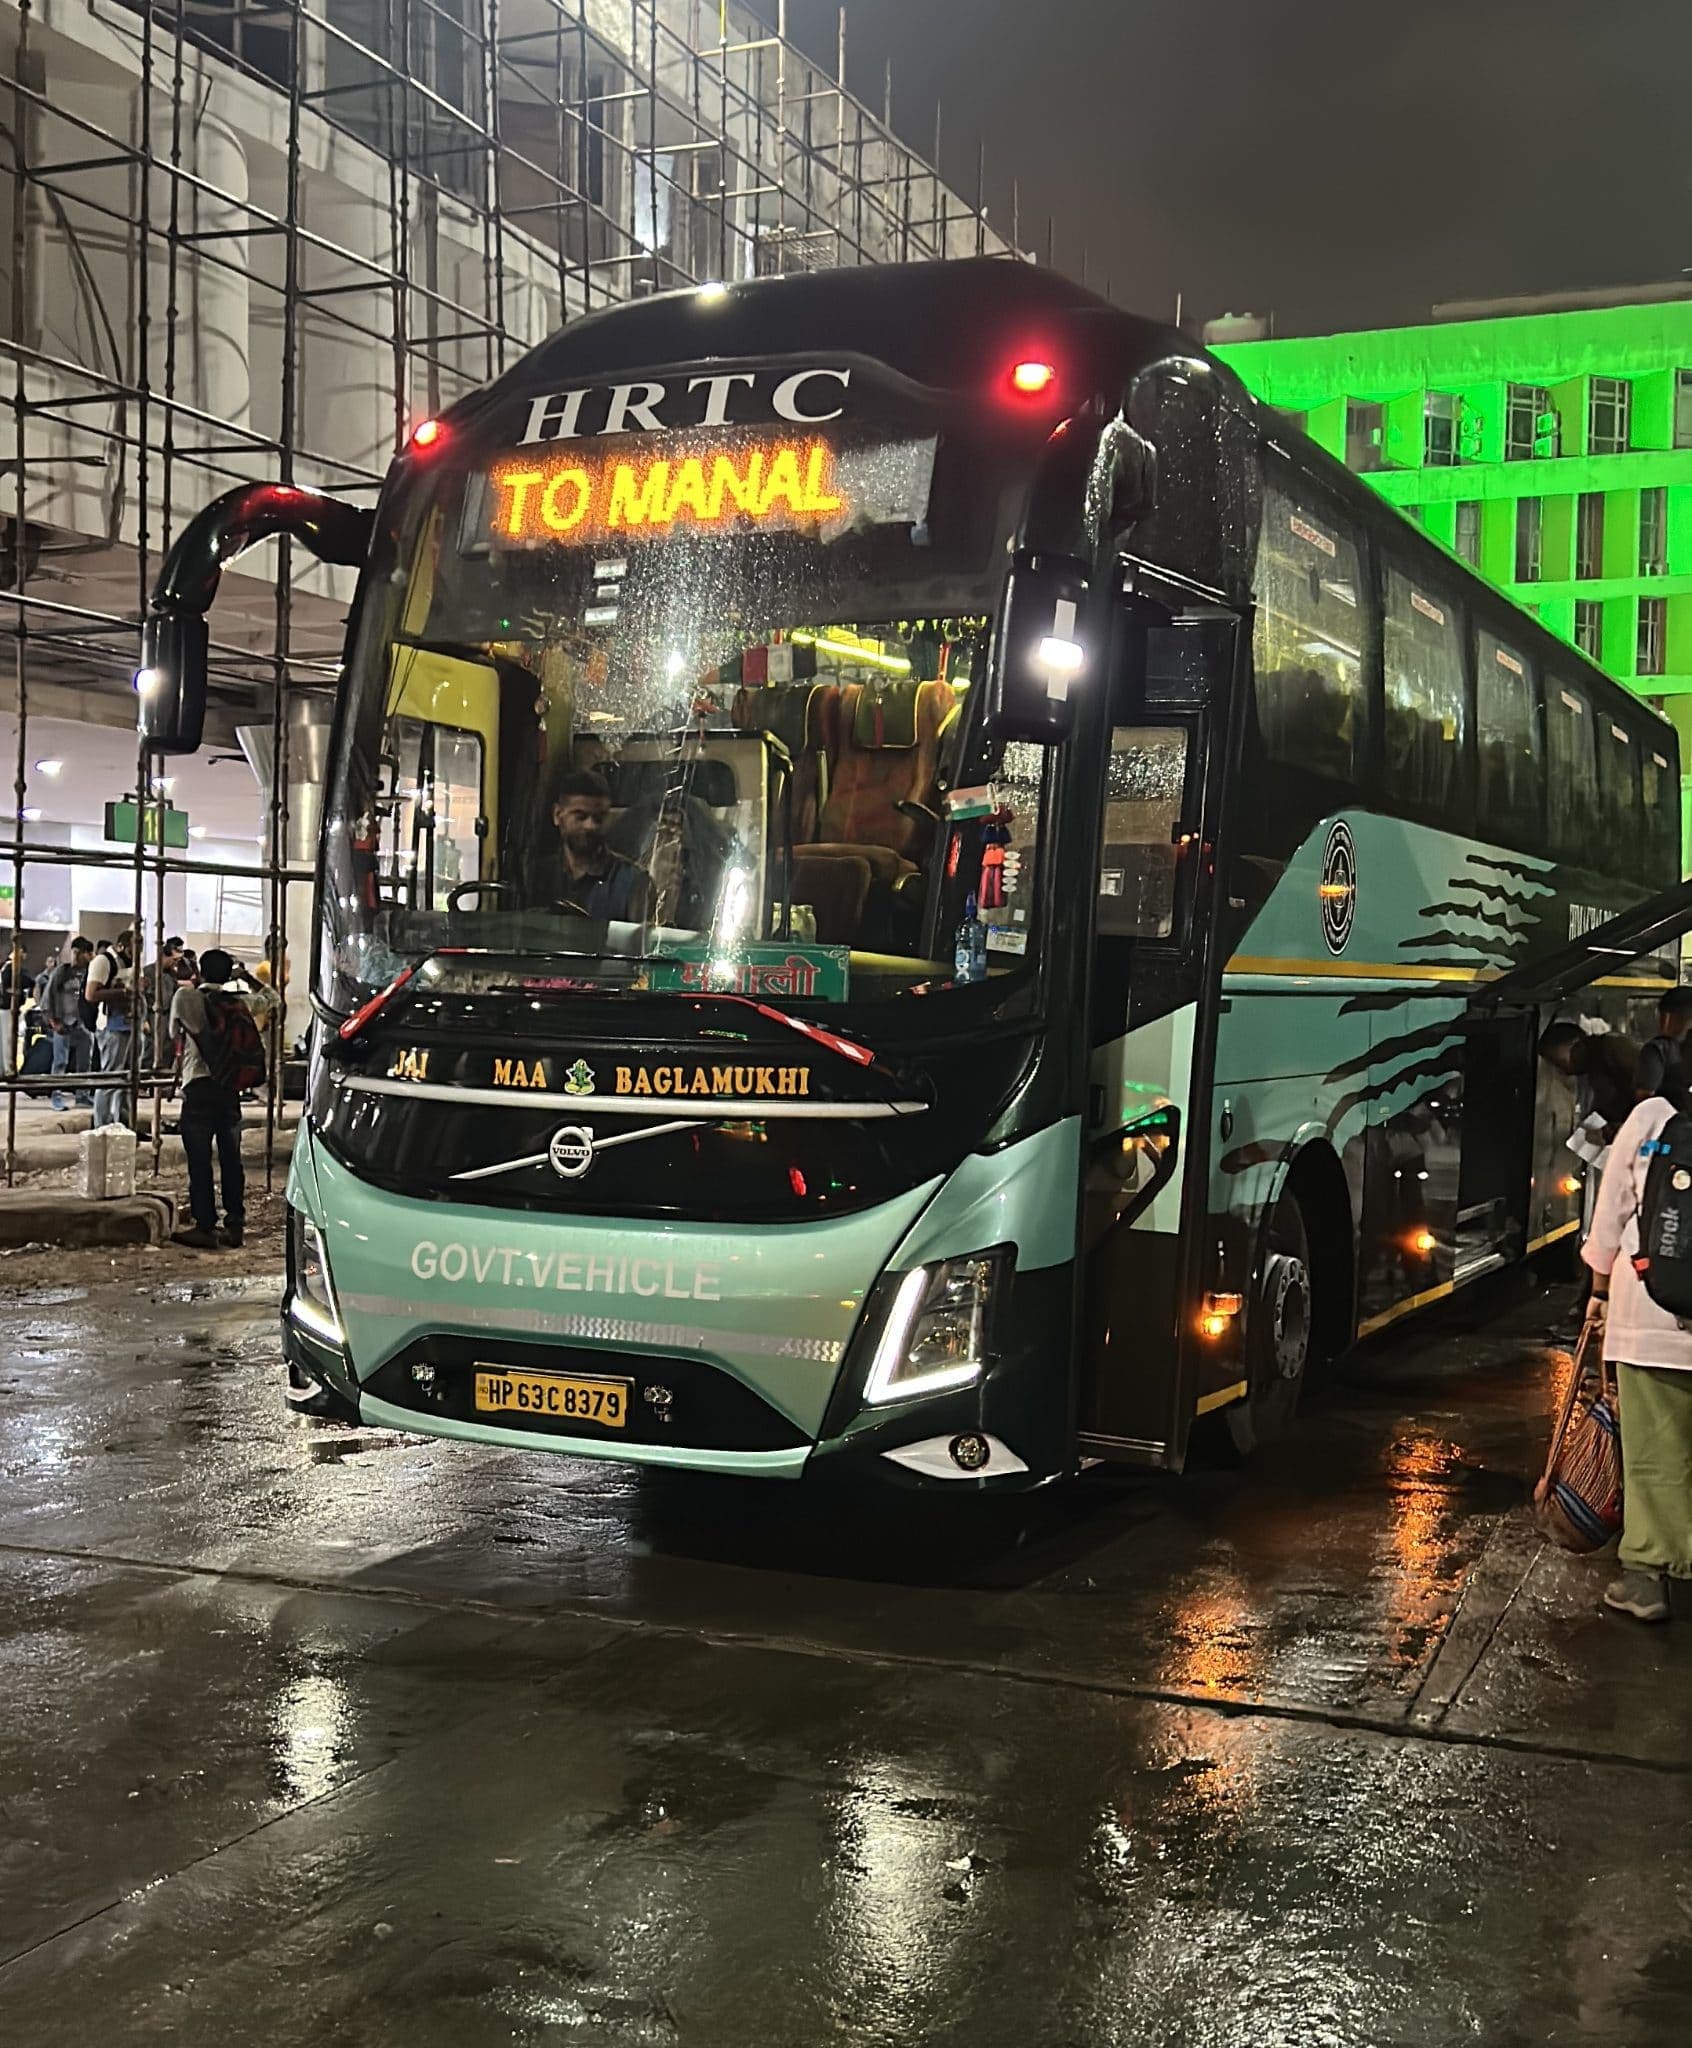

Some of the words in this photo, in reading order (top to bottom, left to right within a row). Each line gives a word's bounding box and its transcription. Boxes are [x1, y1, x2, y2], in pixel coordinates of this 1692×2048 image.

[516, 369, 851, 446] HRTC
[502, 470, 592, 534] TO
[607, 446, 842, 528] MANAL
[393, 1050, 430, 1080] JAI
[493, 1058, 548, 1088] MAA
[615, 1066, 811, 1095] BAGLAMUKHI
[552, 1147, 590, 1158] VOLVO
